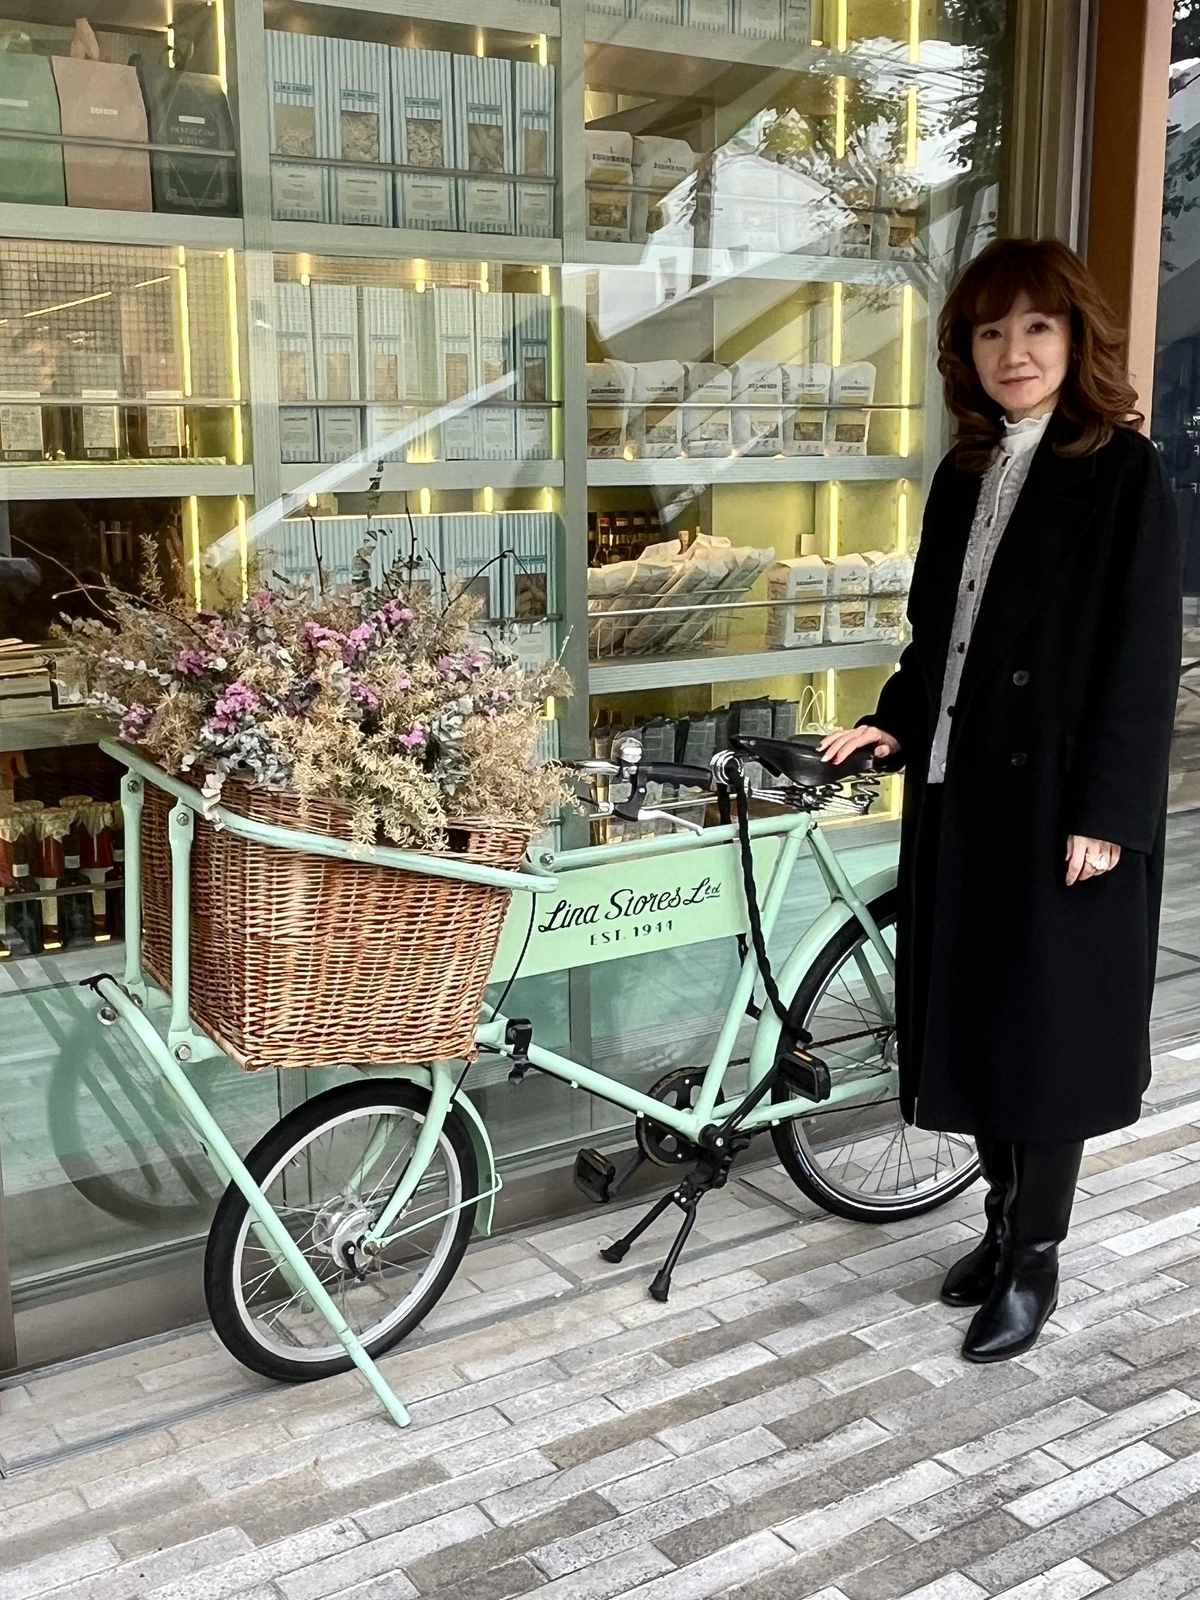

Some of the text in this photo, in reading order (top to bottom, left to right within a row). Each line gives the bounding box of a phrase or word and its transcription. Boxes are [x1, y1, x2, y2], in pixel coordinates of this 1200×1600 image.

[538, 877, 721, 932] Lina Stores Ltd
[590, 929, 626, 946] EST.
